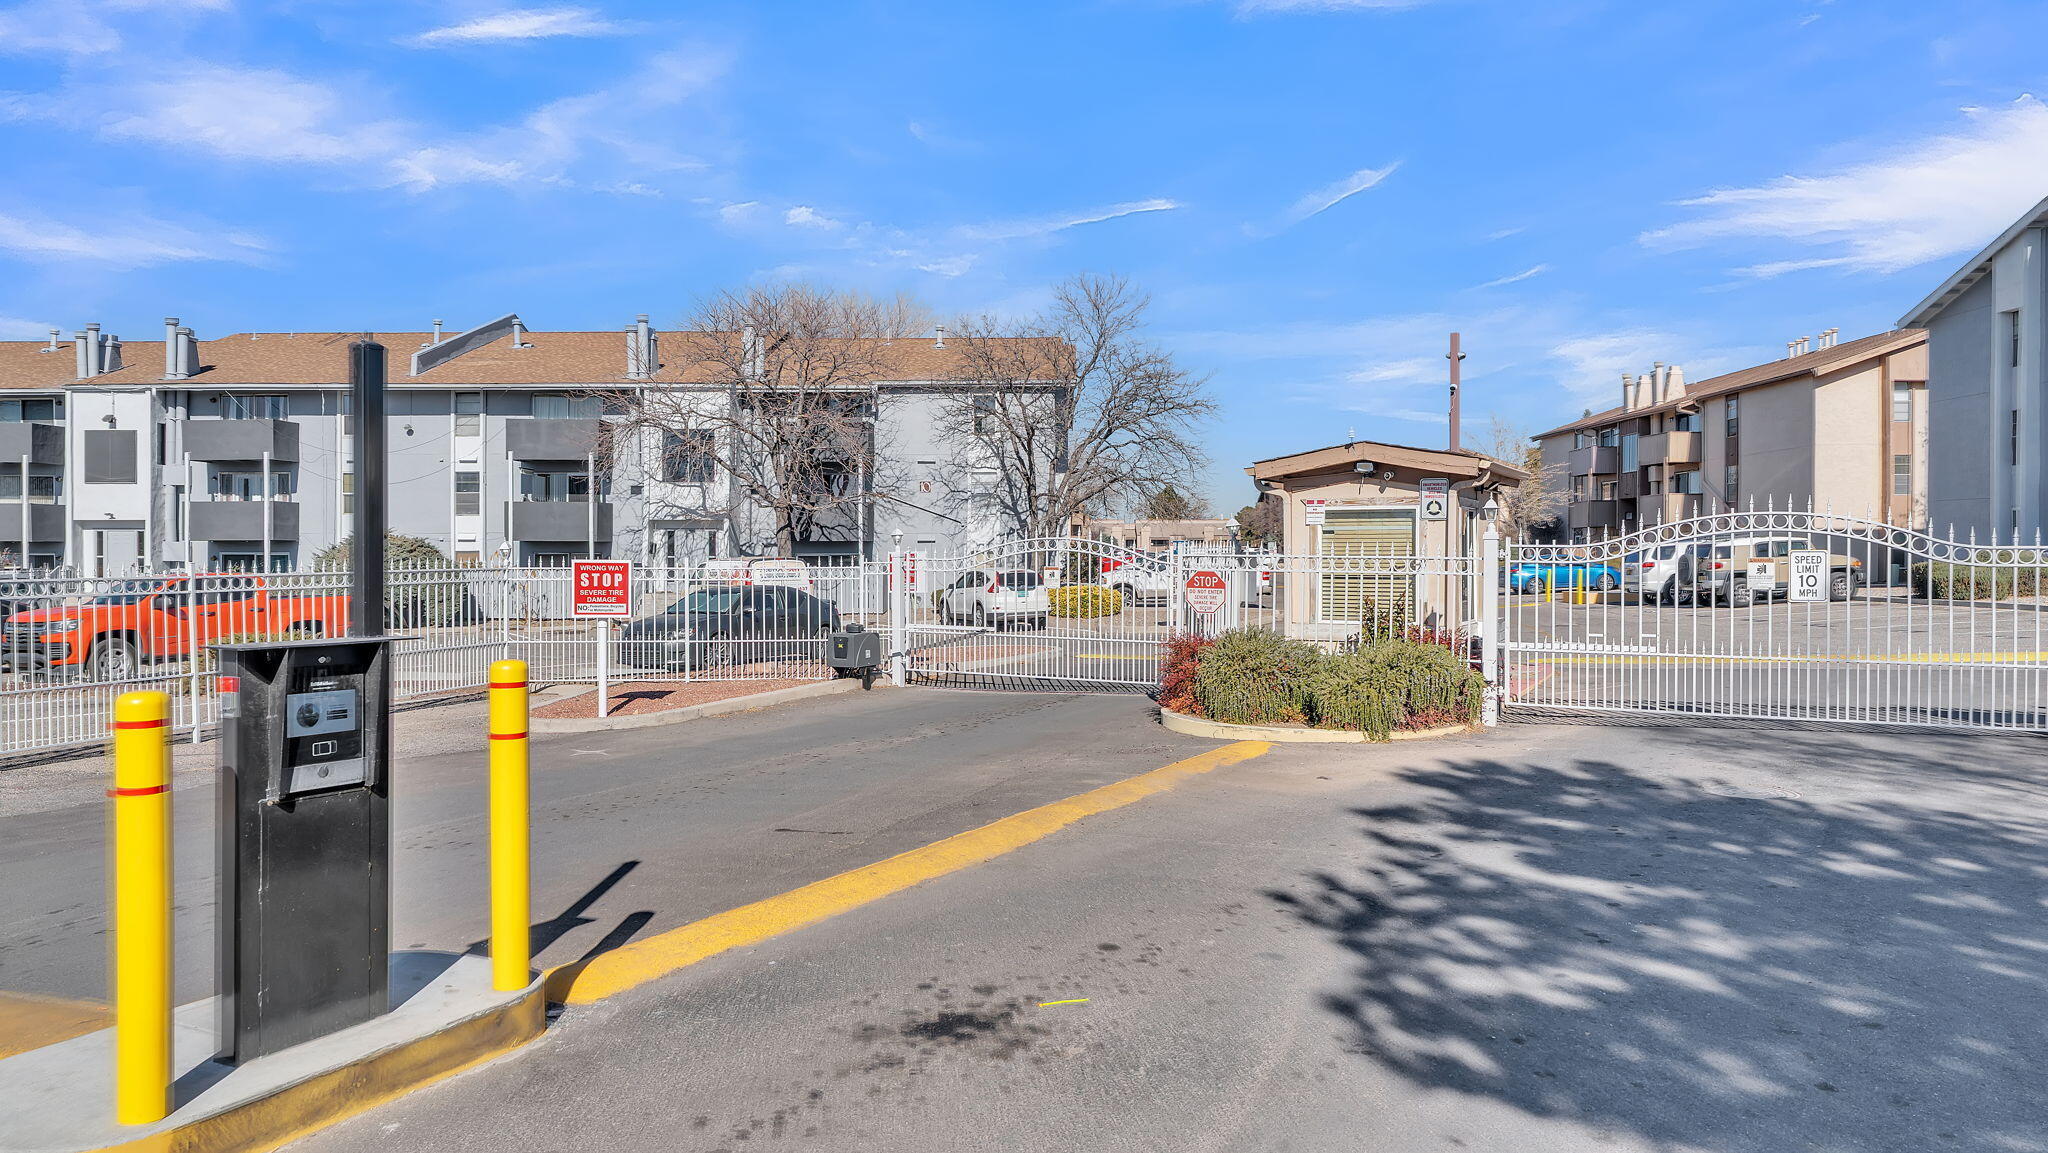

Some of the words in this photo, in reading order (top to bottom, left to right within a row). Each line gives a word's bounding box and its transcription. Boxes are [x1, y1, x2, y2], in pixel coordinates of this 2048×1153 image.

[1794, 555, 1822, 564] SPEED
[1796, 565, 1819, 574] LIMIT
[580, 572, 623, 587] STOP
[1193, 576, 1218, 587] STOP
[1798, 574, 1817, 588] 10
[1798, 588, 1818, 598] MPH
